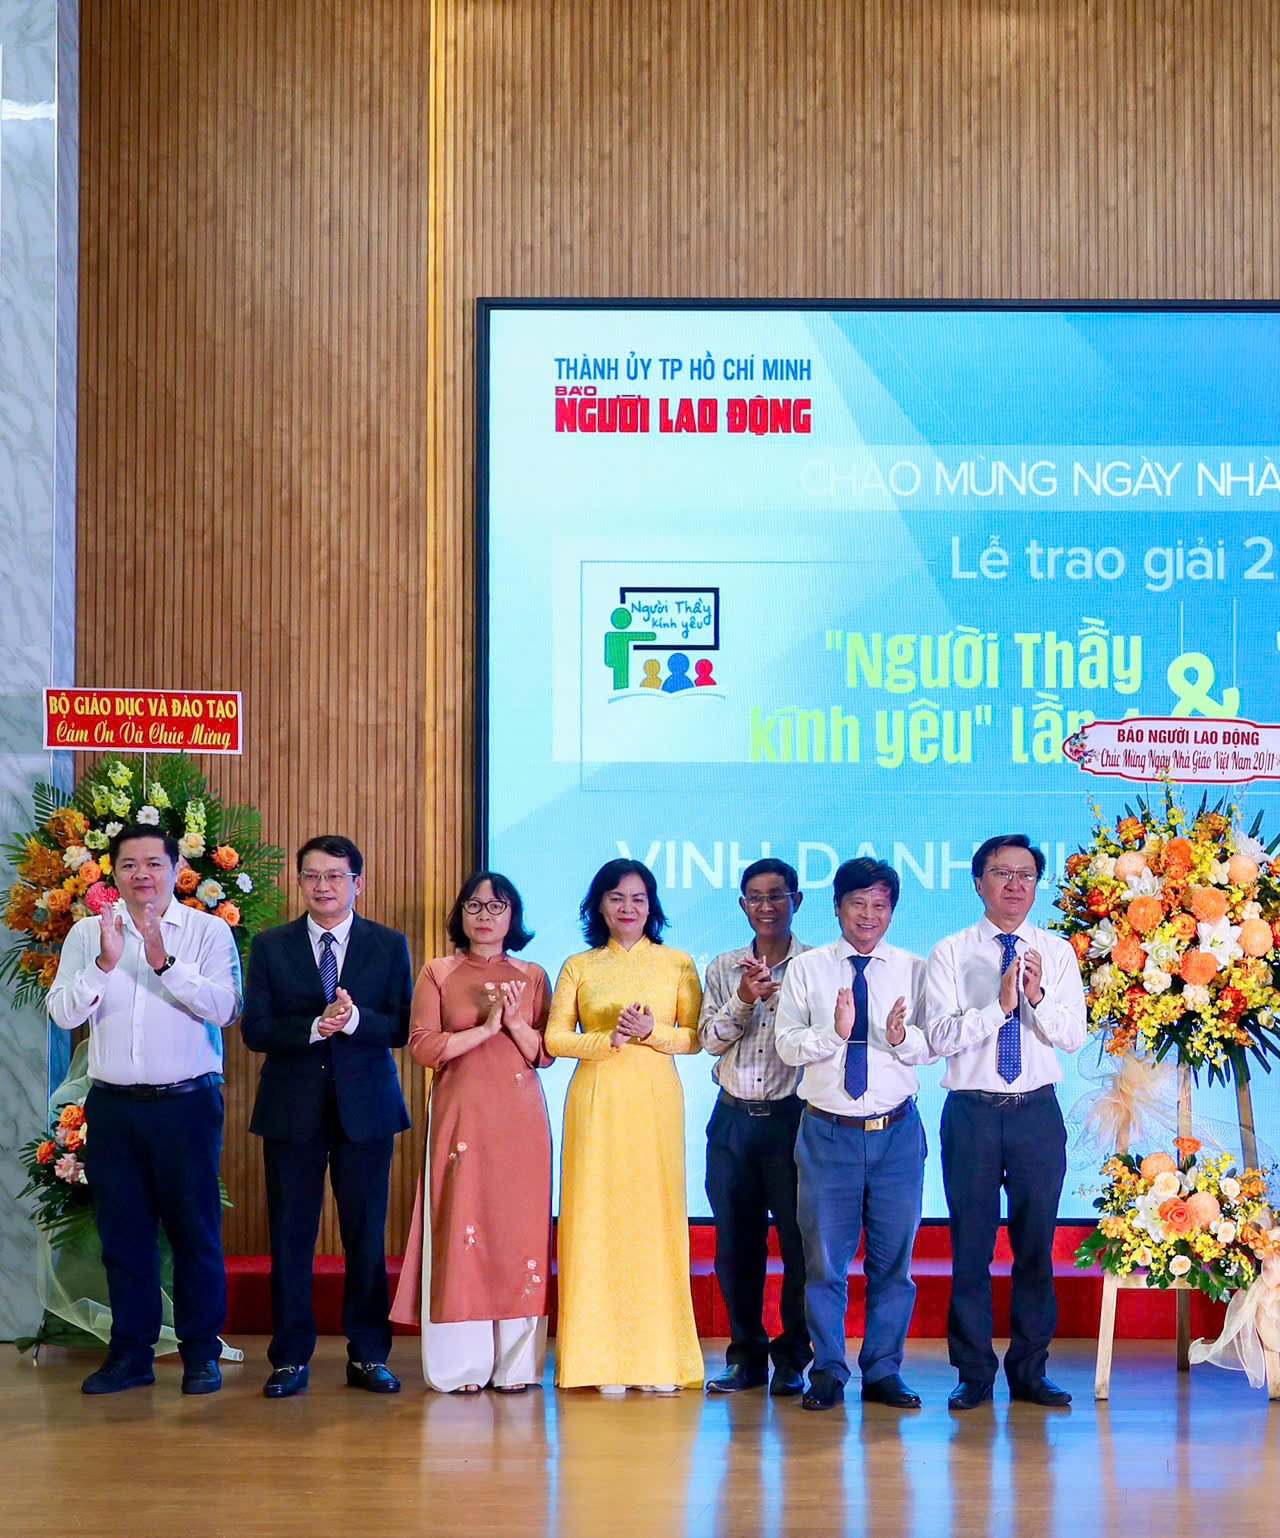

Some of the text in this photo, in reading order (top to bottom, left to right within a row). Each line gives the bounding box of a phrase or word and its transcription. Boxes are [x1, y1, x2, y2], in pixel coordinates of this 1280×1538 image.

[554, 350, 812, 381] THÀNH ỦY TP HỒ CHÍ MINH
[659, 397, 719, 433] LAO
[726, 394, 812, 436] ĐỘNG
[1073, 454, 1182, 498] NGÀY
[951, 534, 1010, 581] Lễ
[1028, 539, 1126, 581] trao
[1143, 536, 1226, 593] giải
[1242, 537, 1276, 581] 2
[825, 616, 1143, 695] "Người Thầy
[1166, 652, 1240, 718] &
[49, 692, 237, 723] BỘ GIÁO DỤC VÀ ĐÀO TẠO
[56, 719, 90, 744] Cảm
[119, 721, 144, 744] Và
[149, 721, 184, 745] Chúc
[187, 723, 232, 751] Mừng
[750, 706, 860, 763] kính
[877, 698, 992, 769] yêu"
[1117, 726, 1260, 749] BÁO NGƯỜI LAO ĐỘNG
[1100, 748, 1276, 775] Chúc Mừng Ngày Nhà Giáo Việt Nam 20/11
